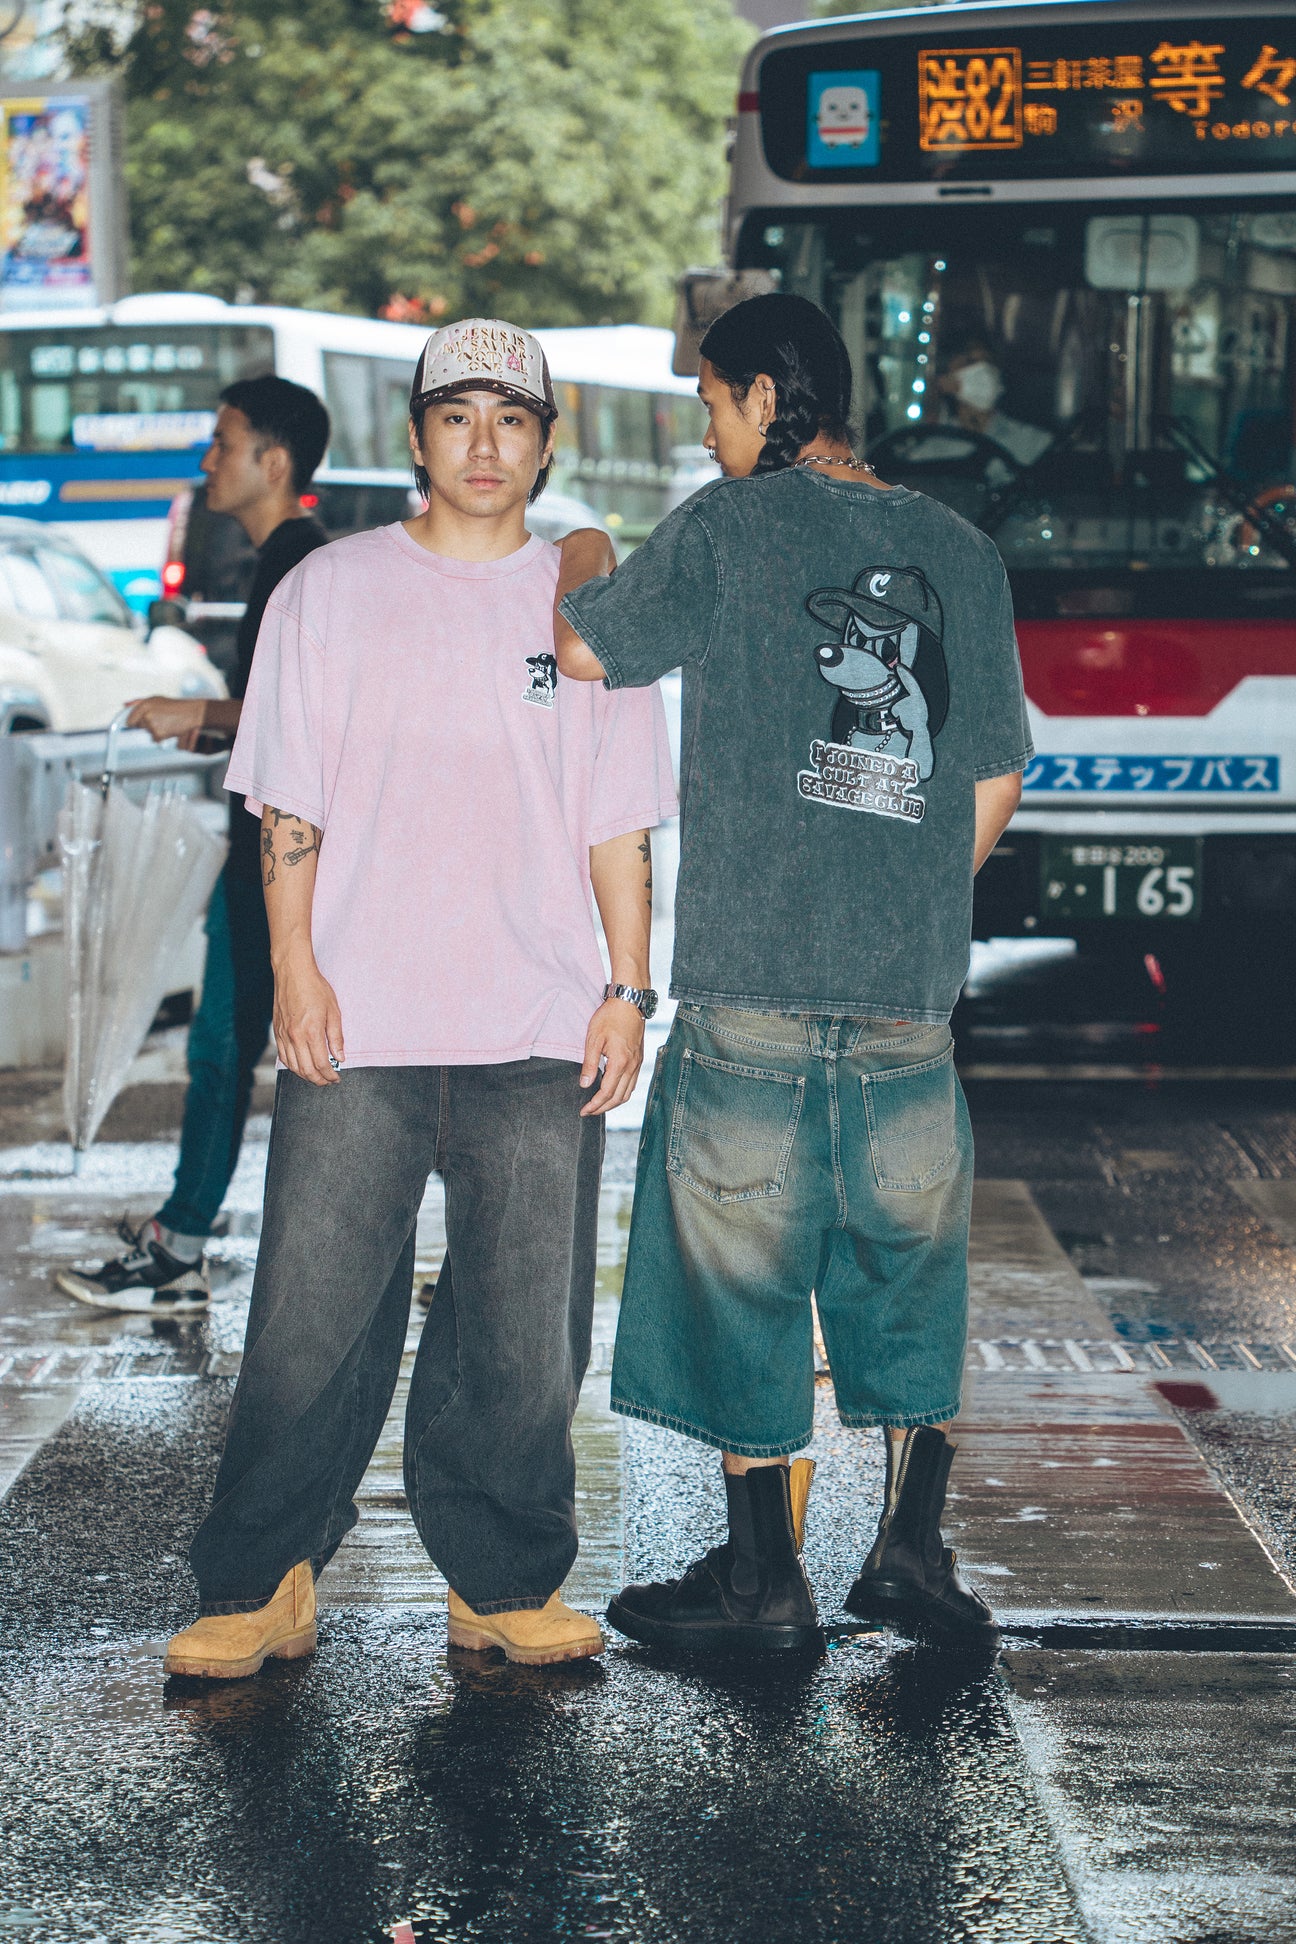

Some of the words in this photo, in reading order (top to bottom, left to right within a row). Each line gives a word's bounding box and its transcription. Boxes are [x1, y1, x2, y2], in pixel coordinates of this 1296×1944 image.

[1192, 120, 1296, 139] Todor
[462, 328, 508, 342] JESUS
[513, 333, 526, 346] IS
[443, 341, 463, 354] MY
[471, 340, 527, 359] SAVIOR
[467, 361, 504, 374] ONE
[869, 573, 891, 597] C
[815, 746, 824, 761] I
[826, 750, 896, 776] JOINED
[901, 765, 915, 780] A
[822, 766, 869, 788] CULT
[876, 777, 905, 794] AT
